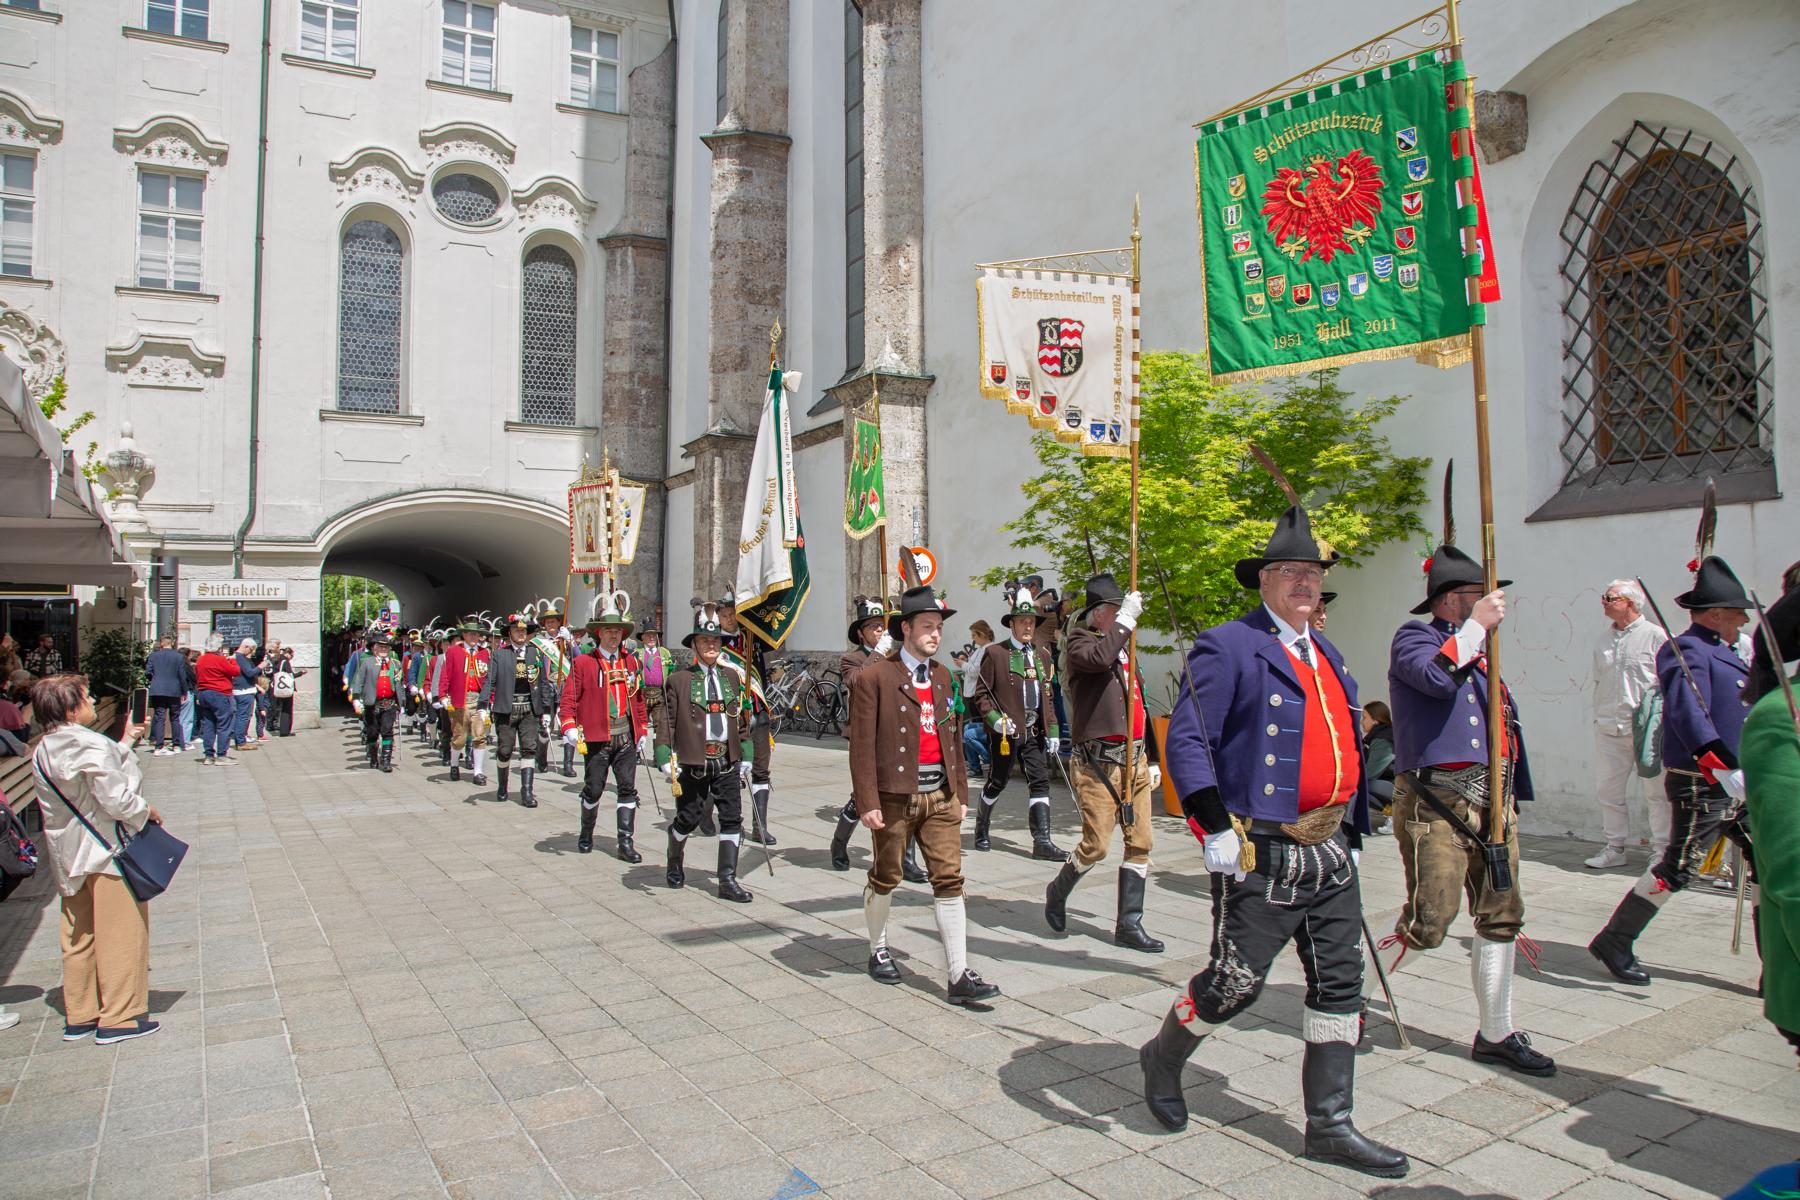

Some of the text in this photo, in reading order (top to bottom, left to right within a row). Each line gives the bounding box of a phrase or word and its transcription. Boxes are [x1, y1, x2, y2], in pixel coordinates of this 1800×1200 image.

[1253, 111, 1383, 164] Schützenbezirk
[1273, 317, 1397, 350] 1951 Hall 2011
[197, 582, 280, 597] Stiftskeller
